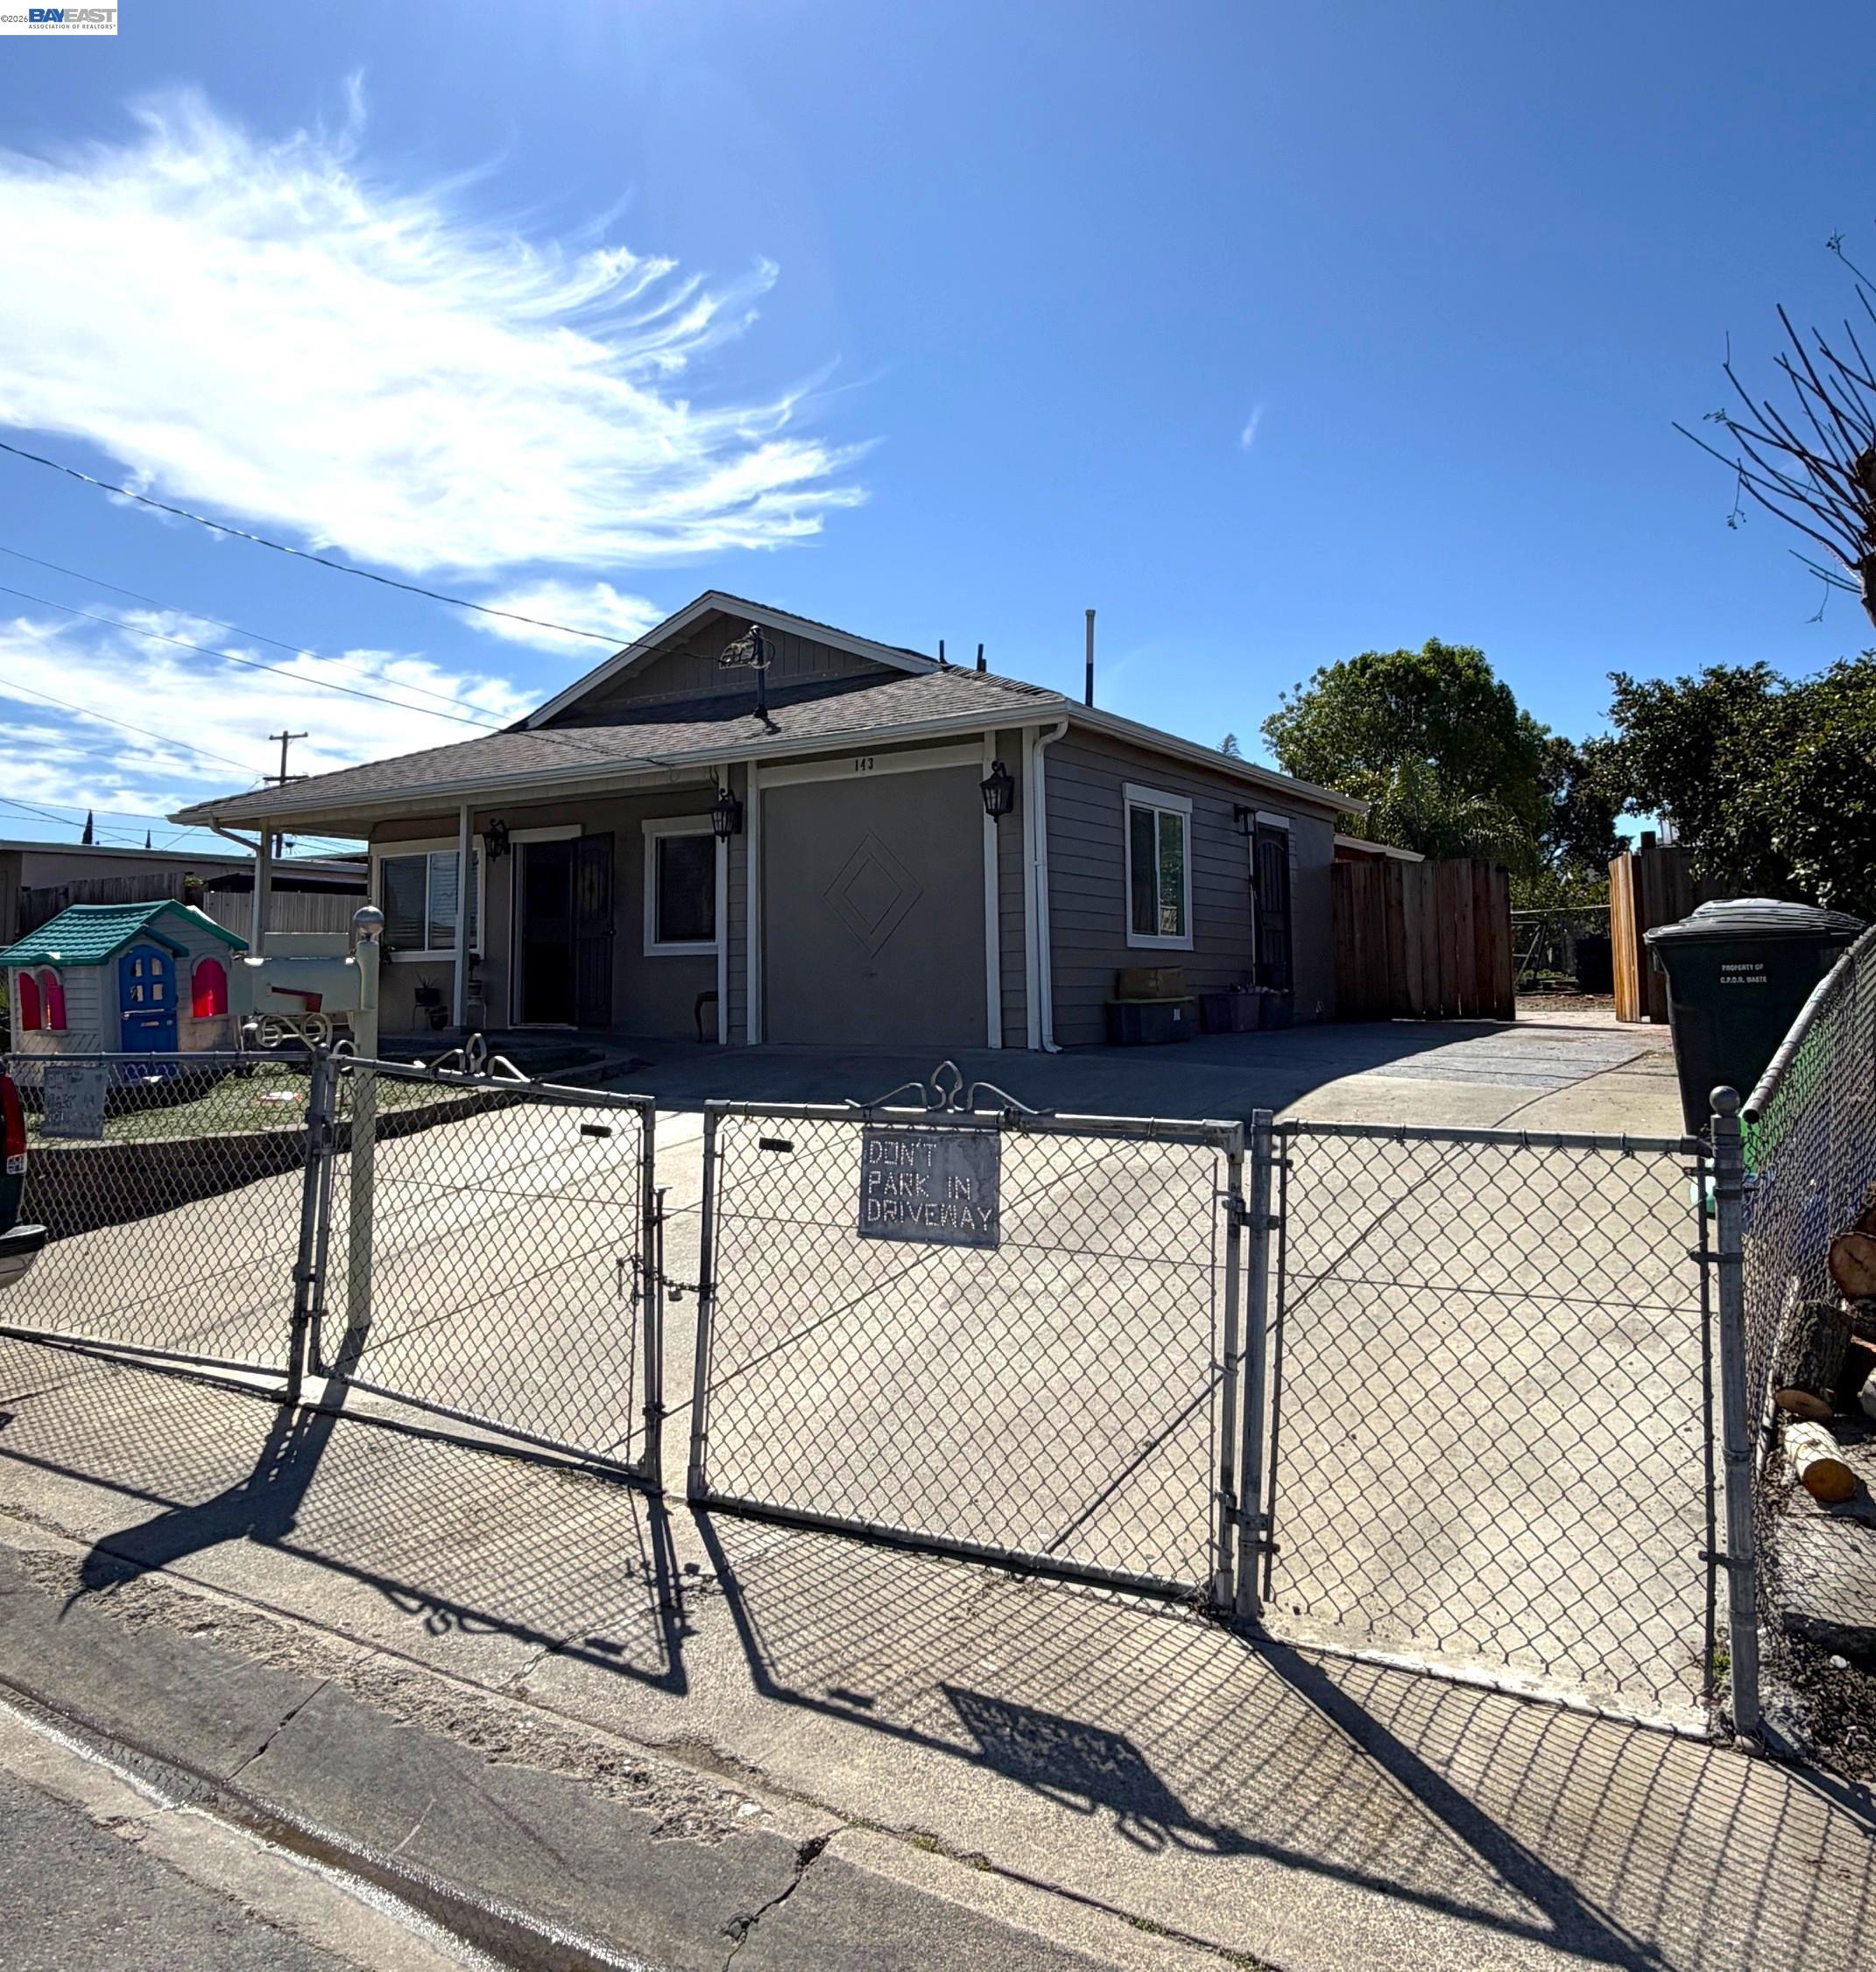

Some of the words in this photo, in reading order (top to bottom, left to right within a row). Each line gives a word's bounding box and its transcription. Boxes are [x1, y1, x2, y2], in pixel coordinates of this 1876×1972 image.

[855, 757, 874, 771] 143
[869, 1137, 937, 1167] DON'T
[868, 1170, 930, 1197] PARK
[948, 1176, 971, 1200] IN
[867, 1198, 992, 1231] DRIVEWAY
